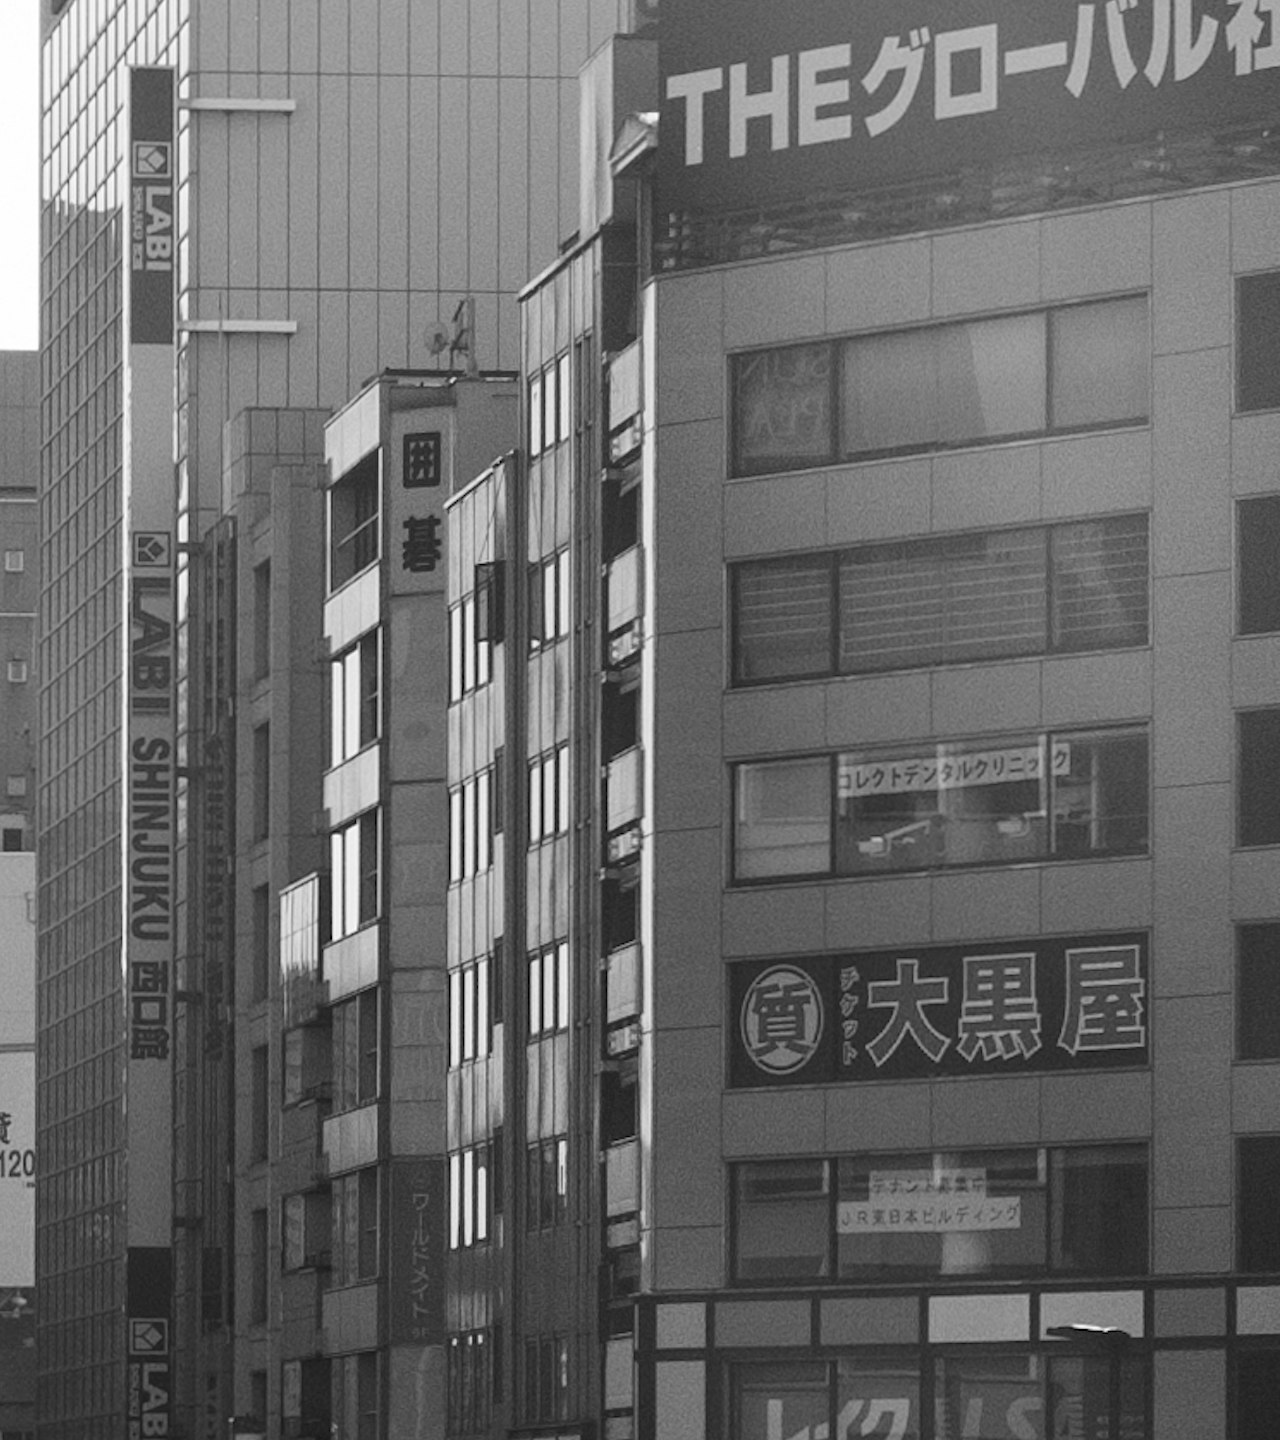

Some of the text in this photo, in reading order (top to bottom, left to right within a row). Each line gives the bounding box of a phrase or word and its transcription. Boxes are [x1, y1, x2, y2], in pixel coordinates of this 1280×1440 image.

[146, 185, 172, 271] LABI
[132, 576, 172, 716] LABI
[132, 738, 172, 943] SHINJUKU
[866, 944, 1147, 1065] 大黒屋
